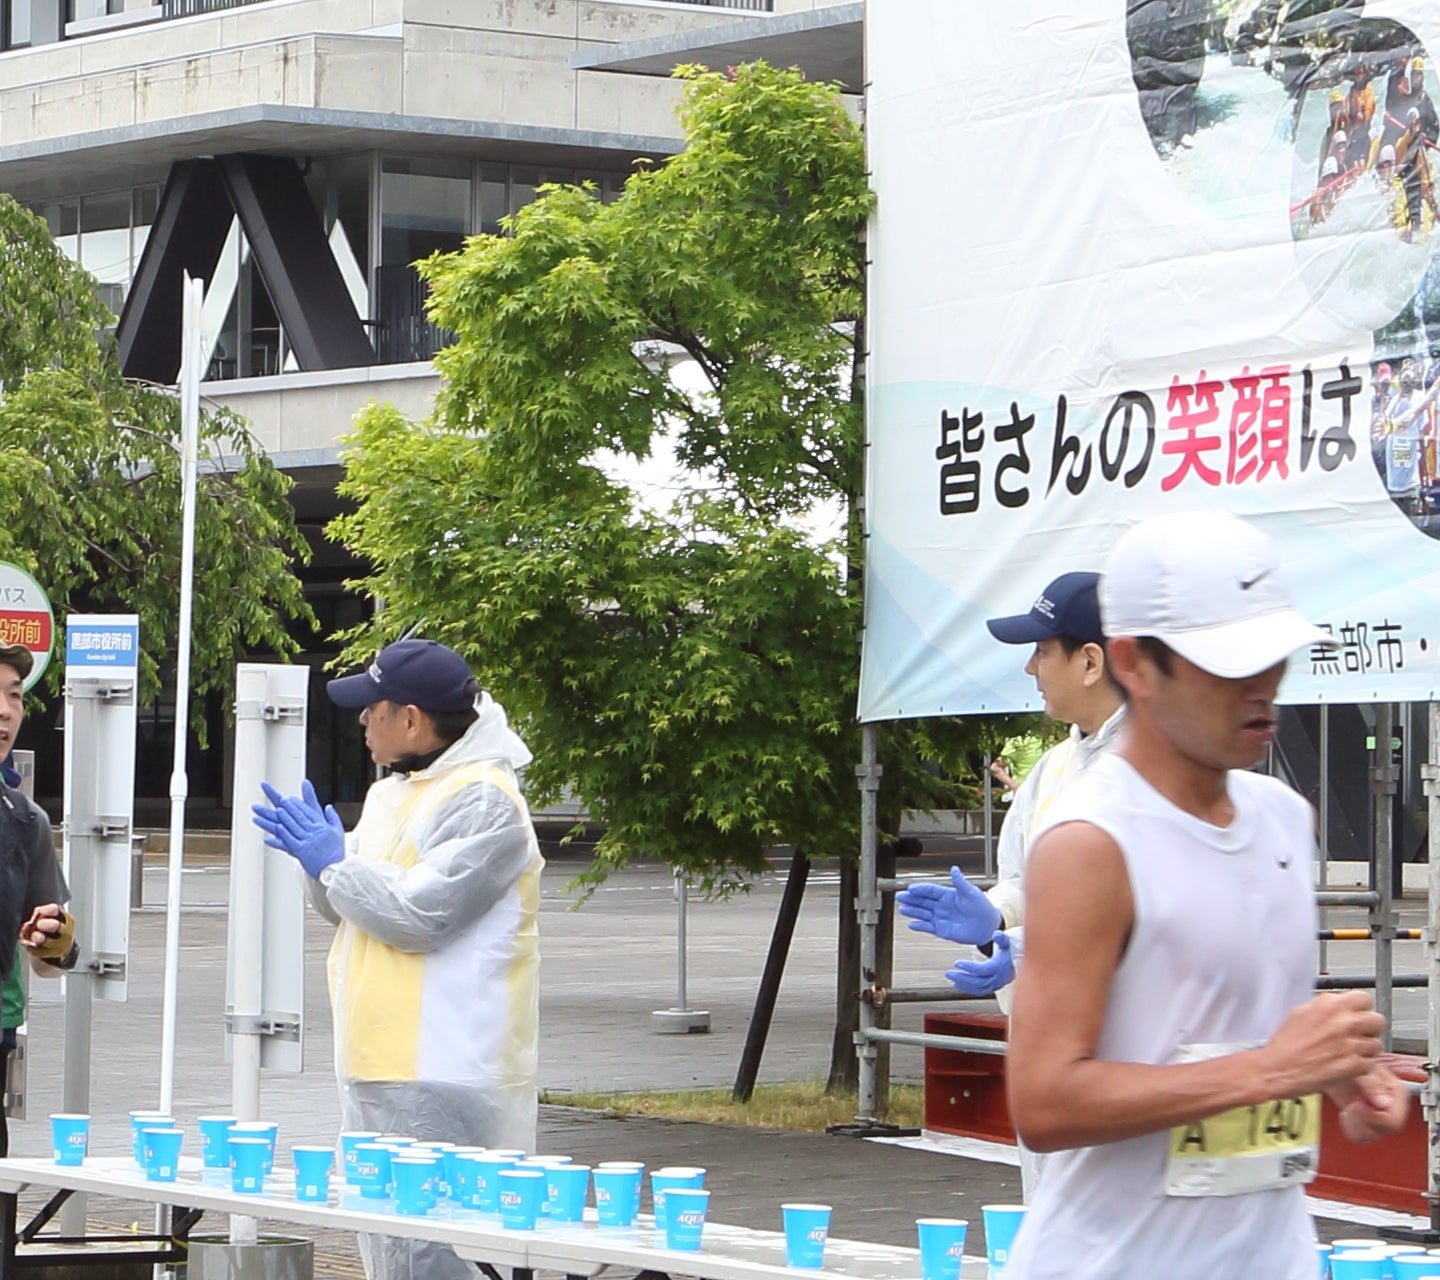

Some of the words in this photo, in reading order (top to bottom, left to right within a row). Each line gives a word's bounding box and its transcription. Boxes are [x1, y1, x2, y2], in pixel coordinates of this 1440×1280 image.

[935, 356, 1363, 517] 皆さんの笑顔は
[70, 632, 132, 651] 黒部市役所前
